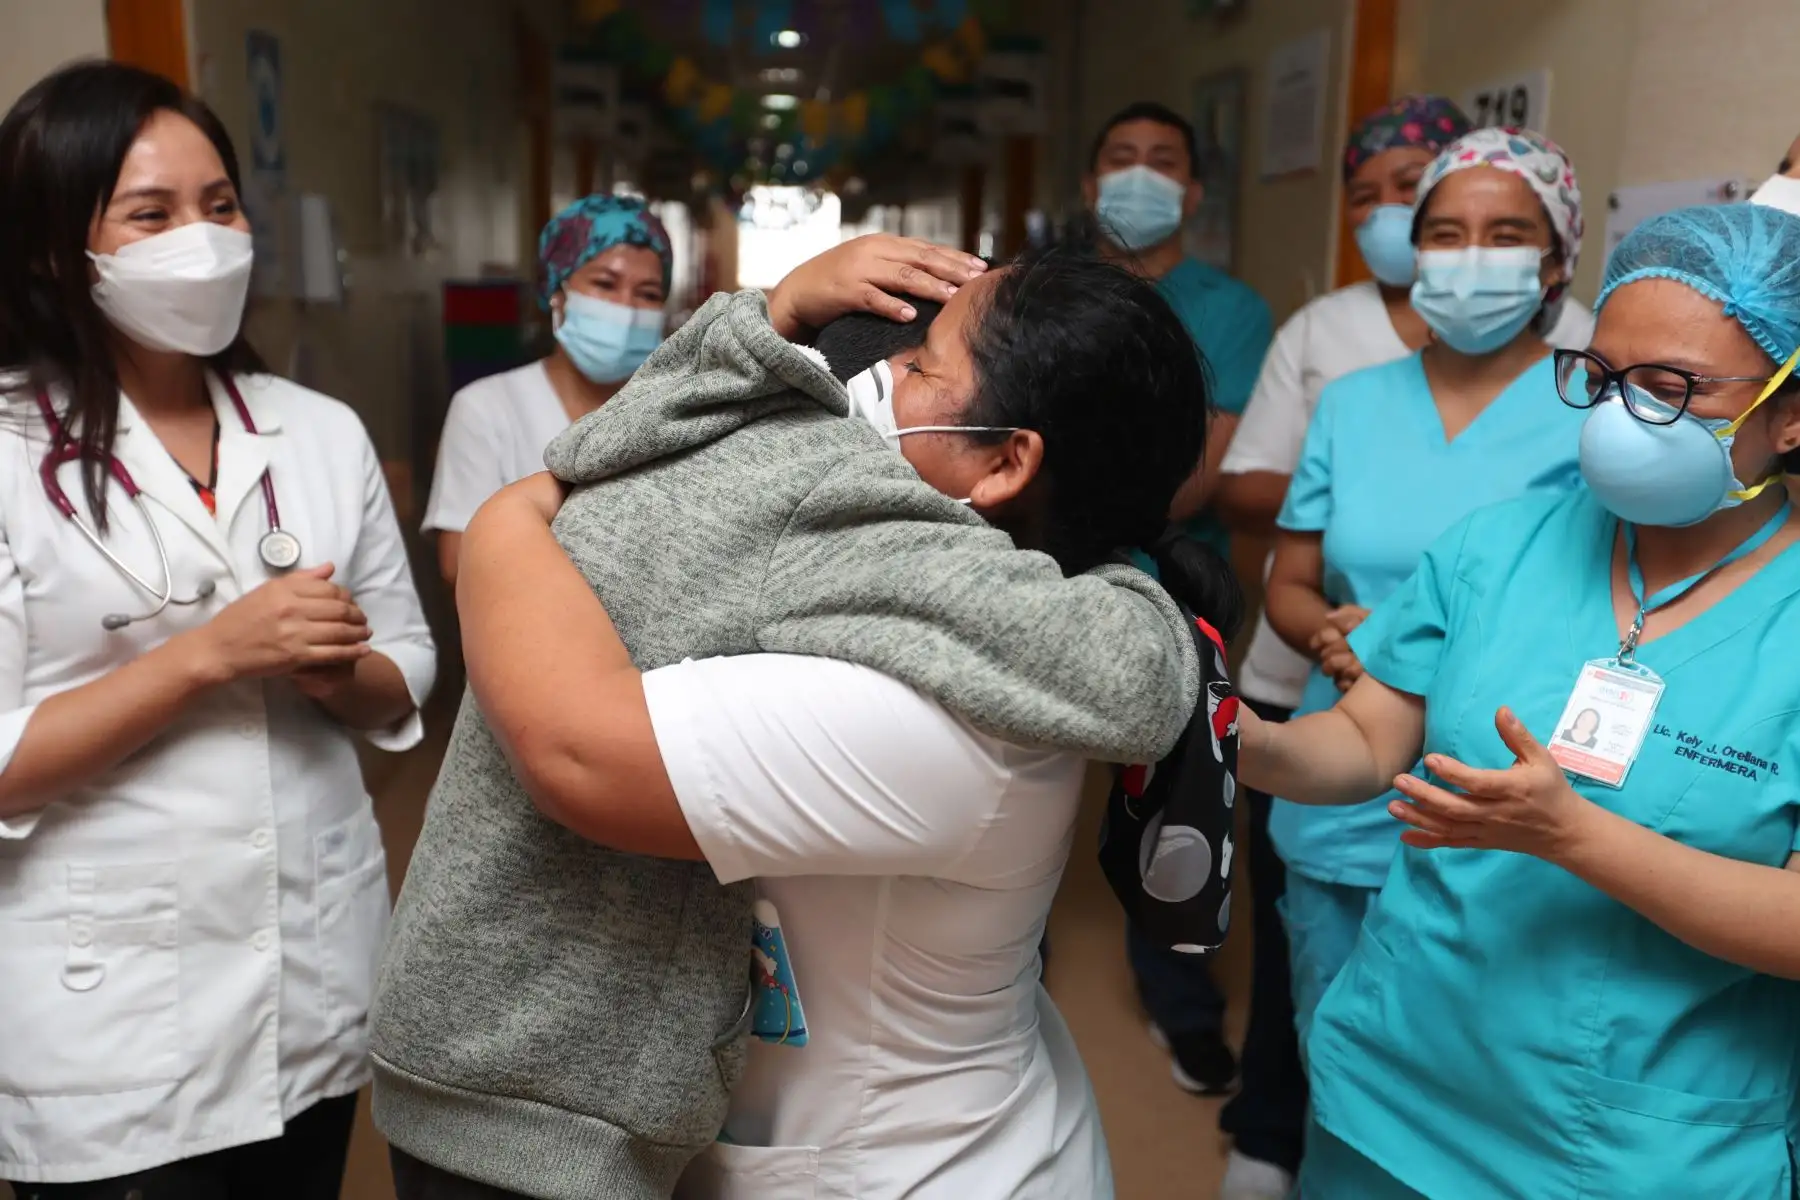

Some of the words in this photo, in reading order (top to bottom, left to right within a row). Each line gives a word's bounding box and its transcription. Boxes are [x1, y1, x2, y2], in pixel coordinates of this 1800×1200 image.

[1653, 724, 1671, 737] Lic.
[1676, 730, 1703, 748] Kely
[1706, 744, 1717, 755] J.
[1722, 745, 1769, 770] Orellana
[1770, 762, 1779, 776] R.
[1674, 746, 1758, 782] ENFERMERA
